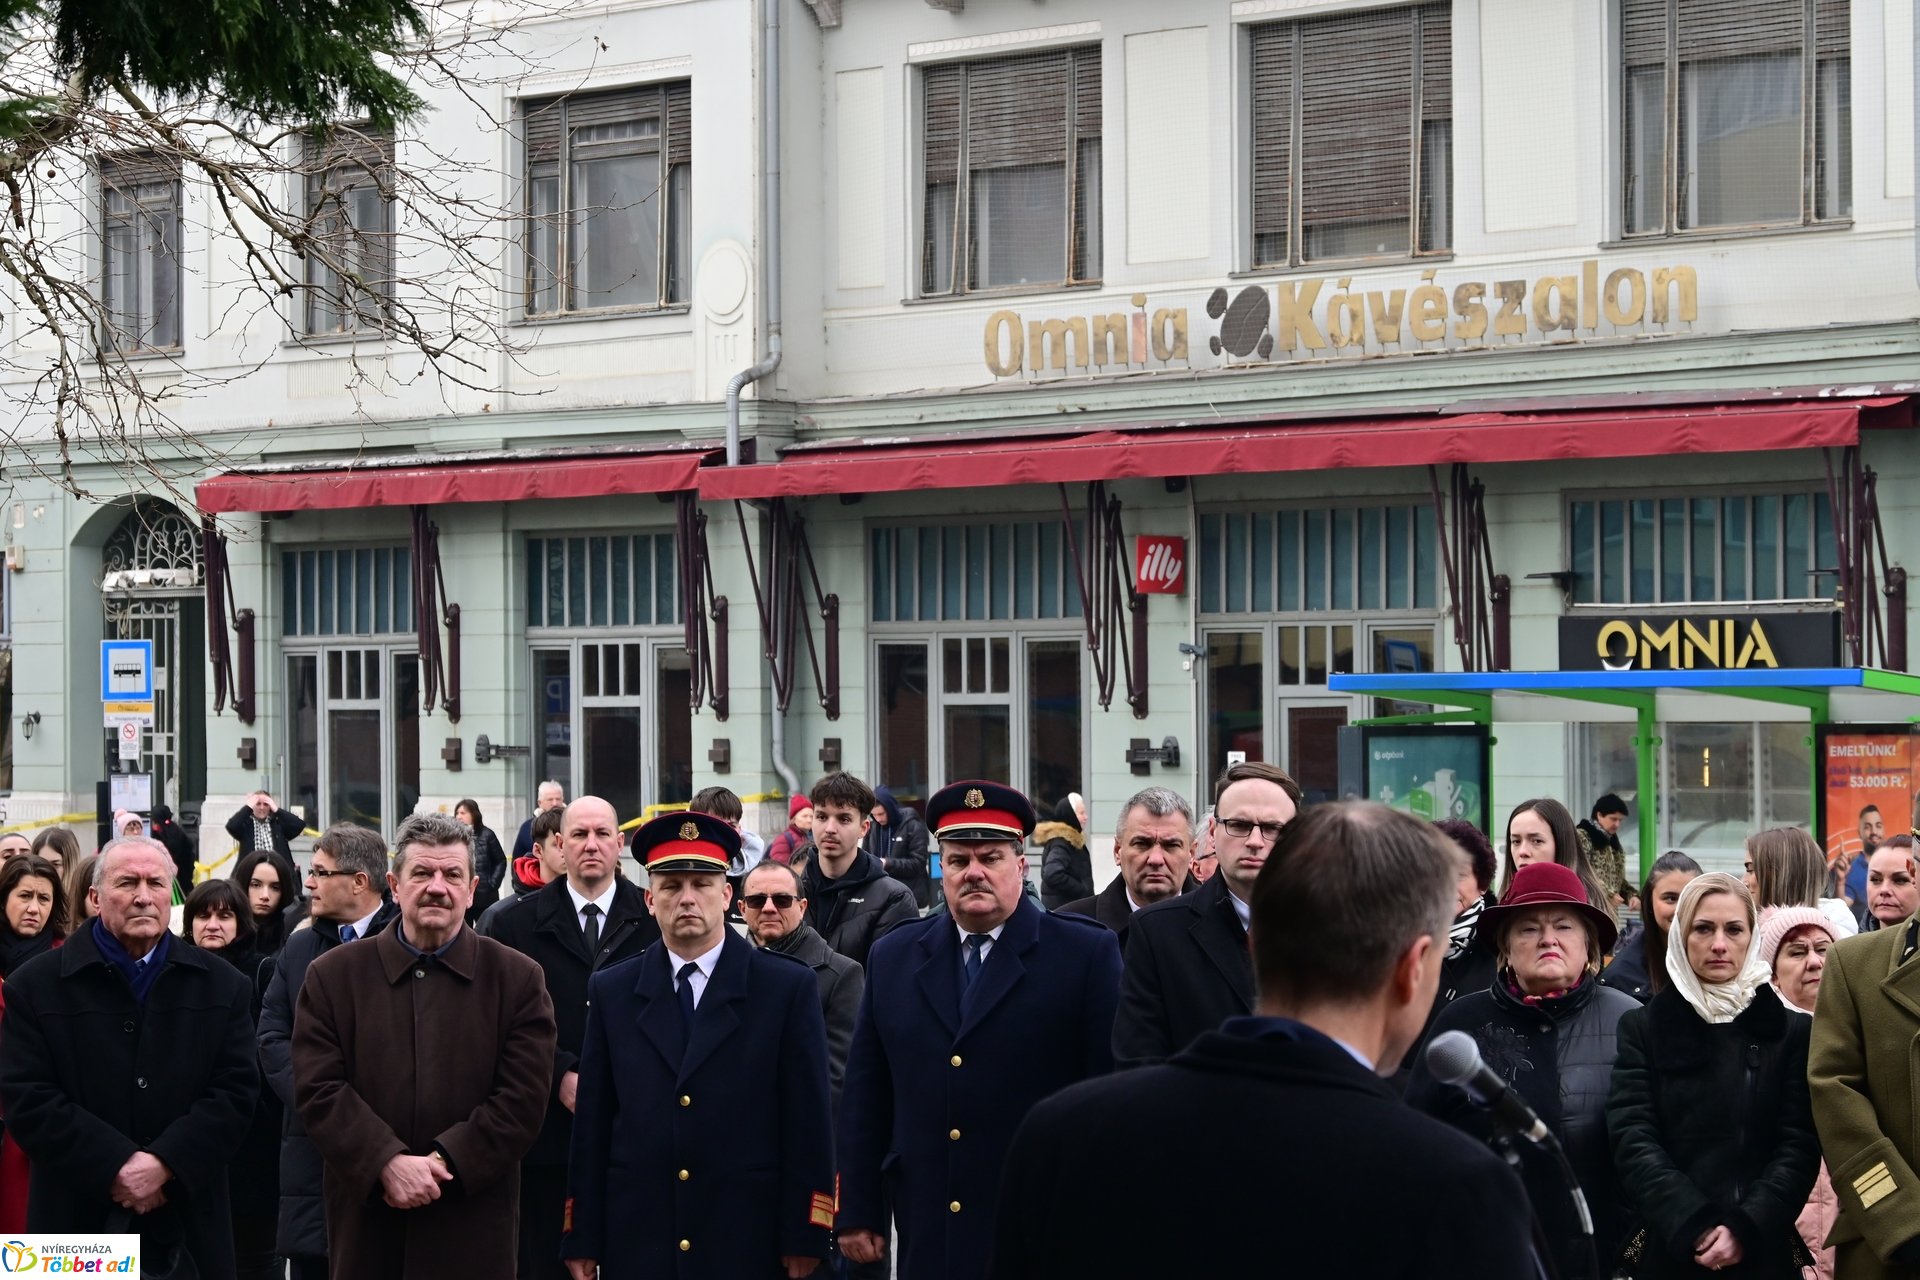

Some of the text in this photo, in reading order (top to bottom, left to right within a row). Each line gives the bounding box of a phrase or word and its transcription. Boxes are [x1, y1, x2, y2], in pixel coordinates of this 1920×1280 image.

[984, 260, 1698, 377] Omnia Kávészalon
[1140, 543, 1182, 589] illy
[1597, 618, 1779, 670] OMNIA
[1829, 742, 1896, 757] EMELTÜNK!
[1850, 776, 1888, 788] 53.000
